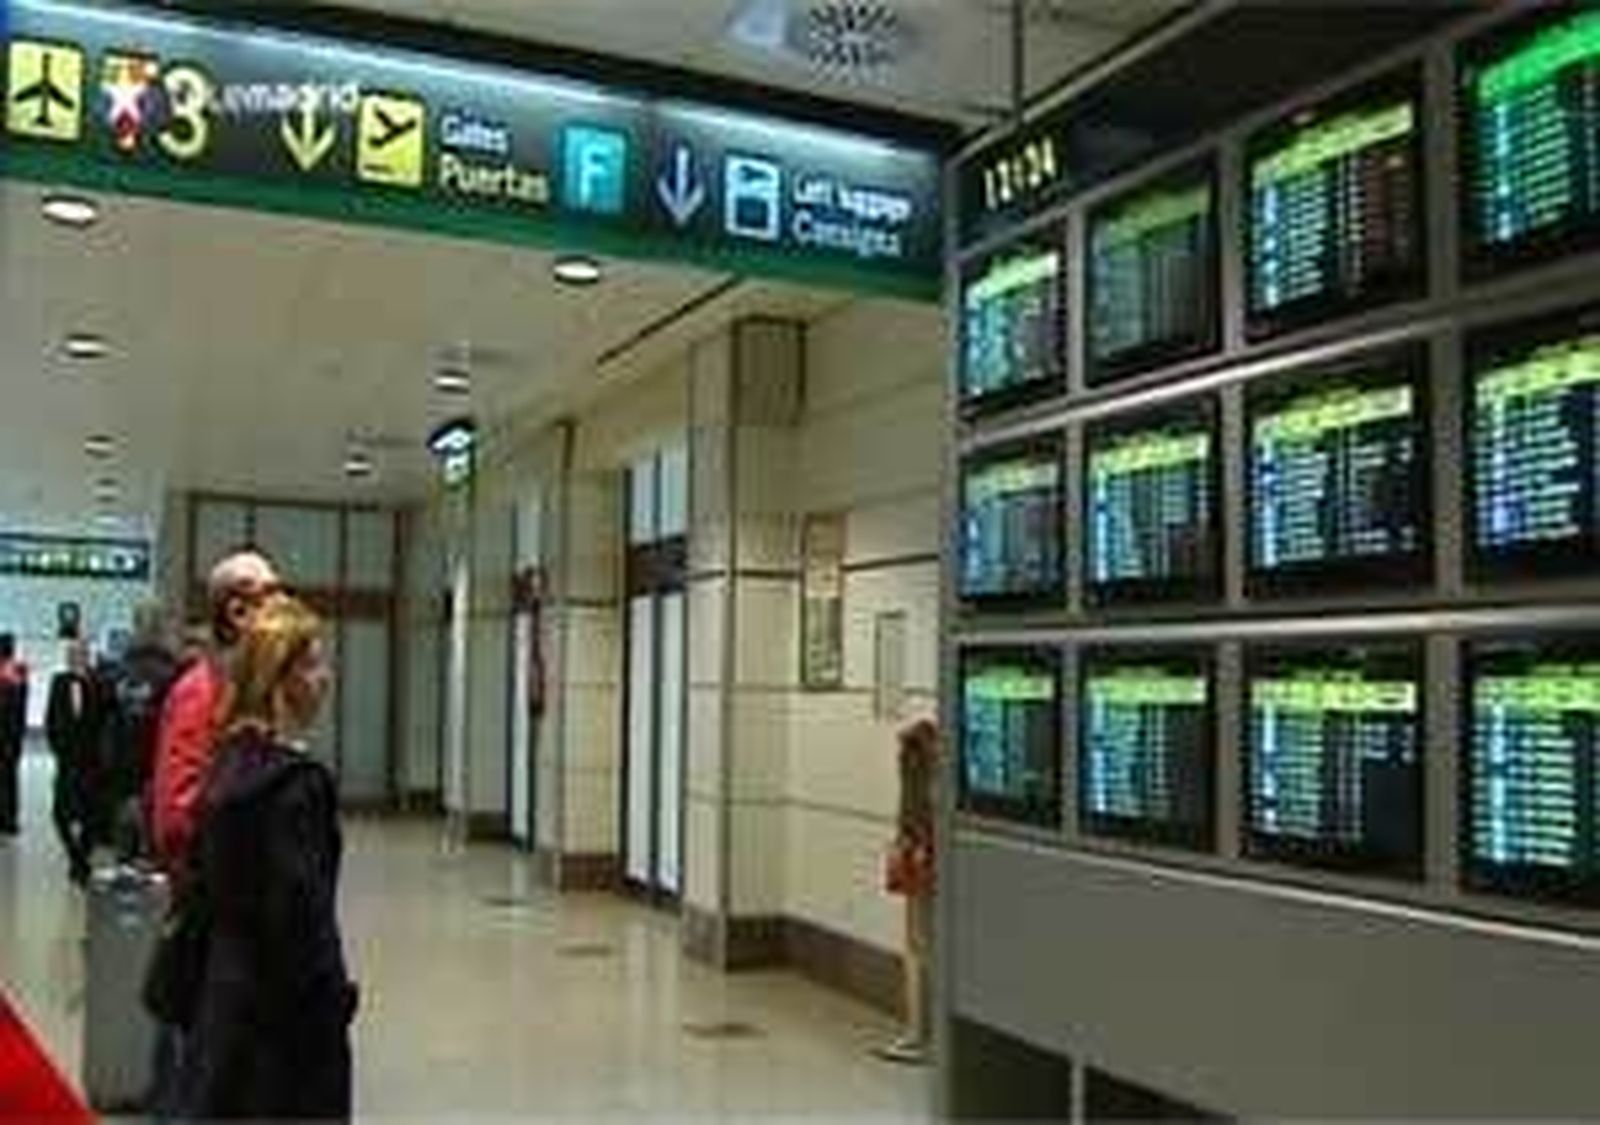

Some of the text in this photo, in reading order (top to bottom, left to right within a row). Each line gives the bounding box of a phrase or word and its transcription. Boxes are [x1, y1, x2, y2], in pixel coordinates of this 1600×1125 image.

[158, 66, 210, 158] 3
[439, 153, 549, 203] Puertas
[579, 142, 608, 207] F
